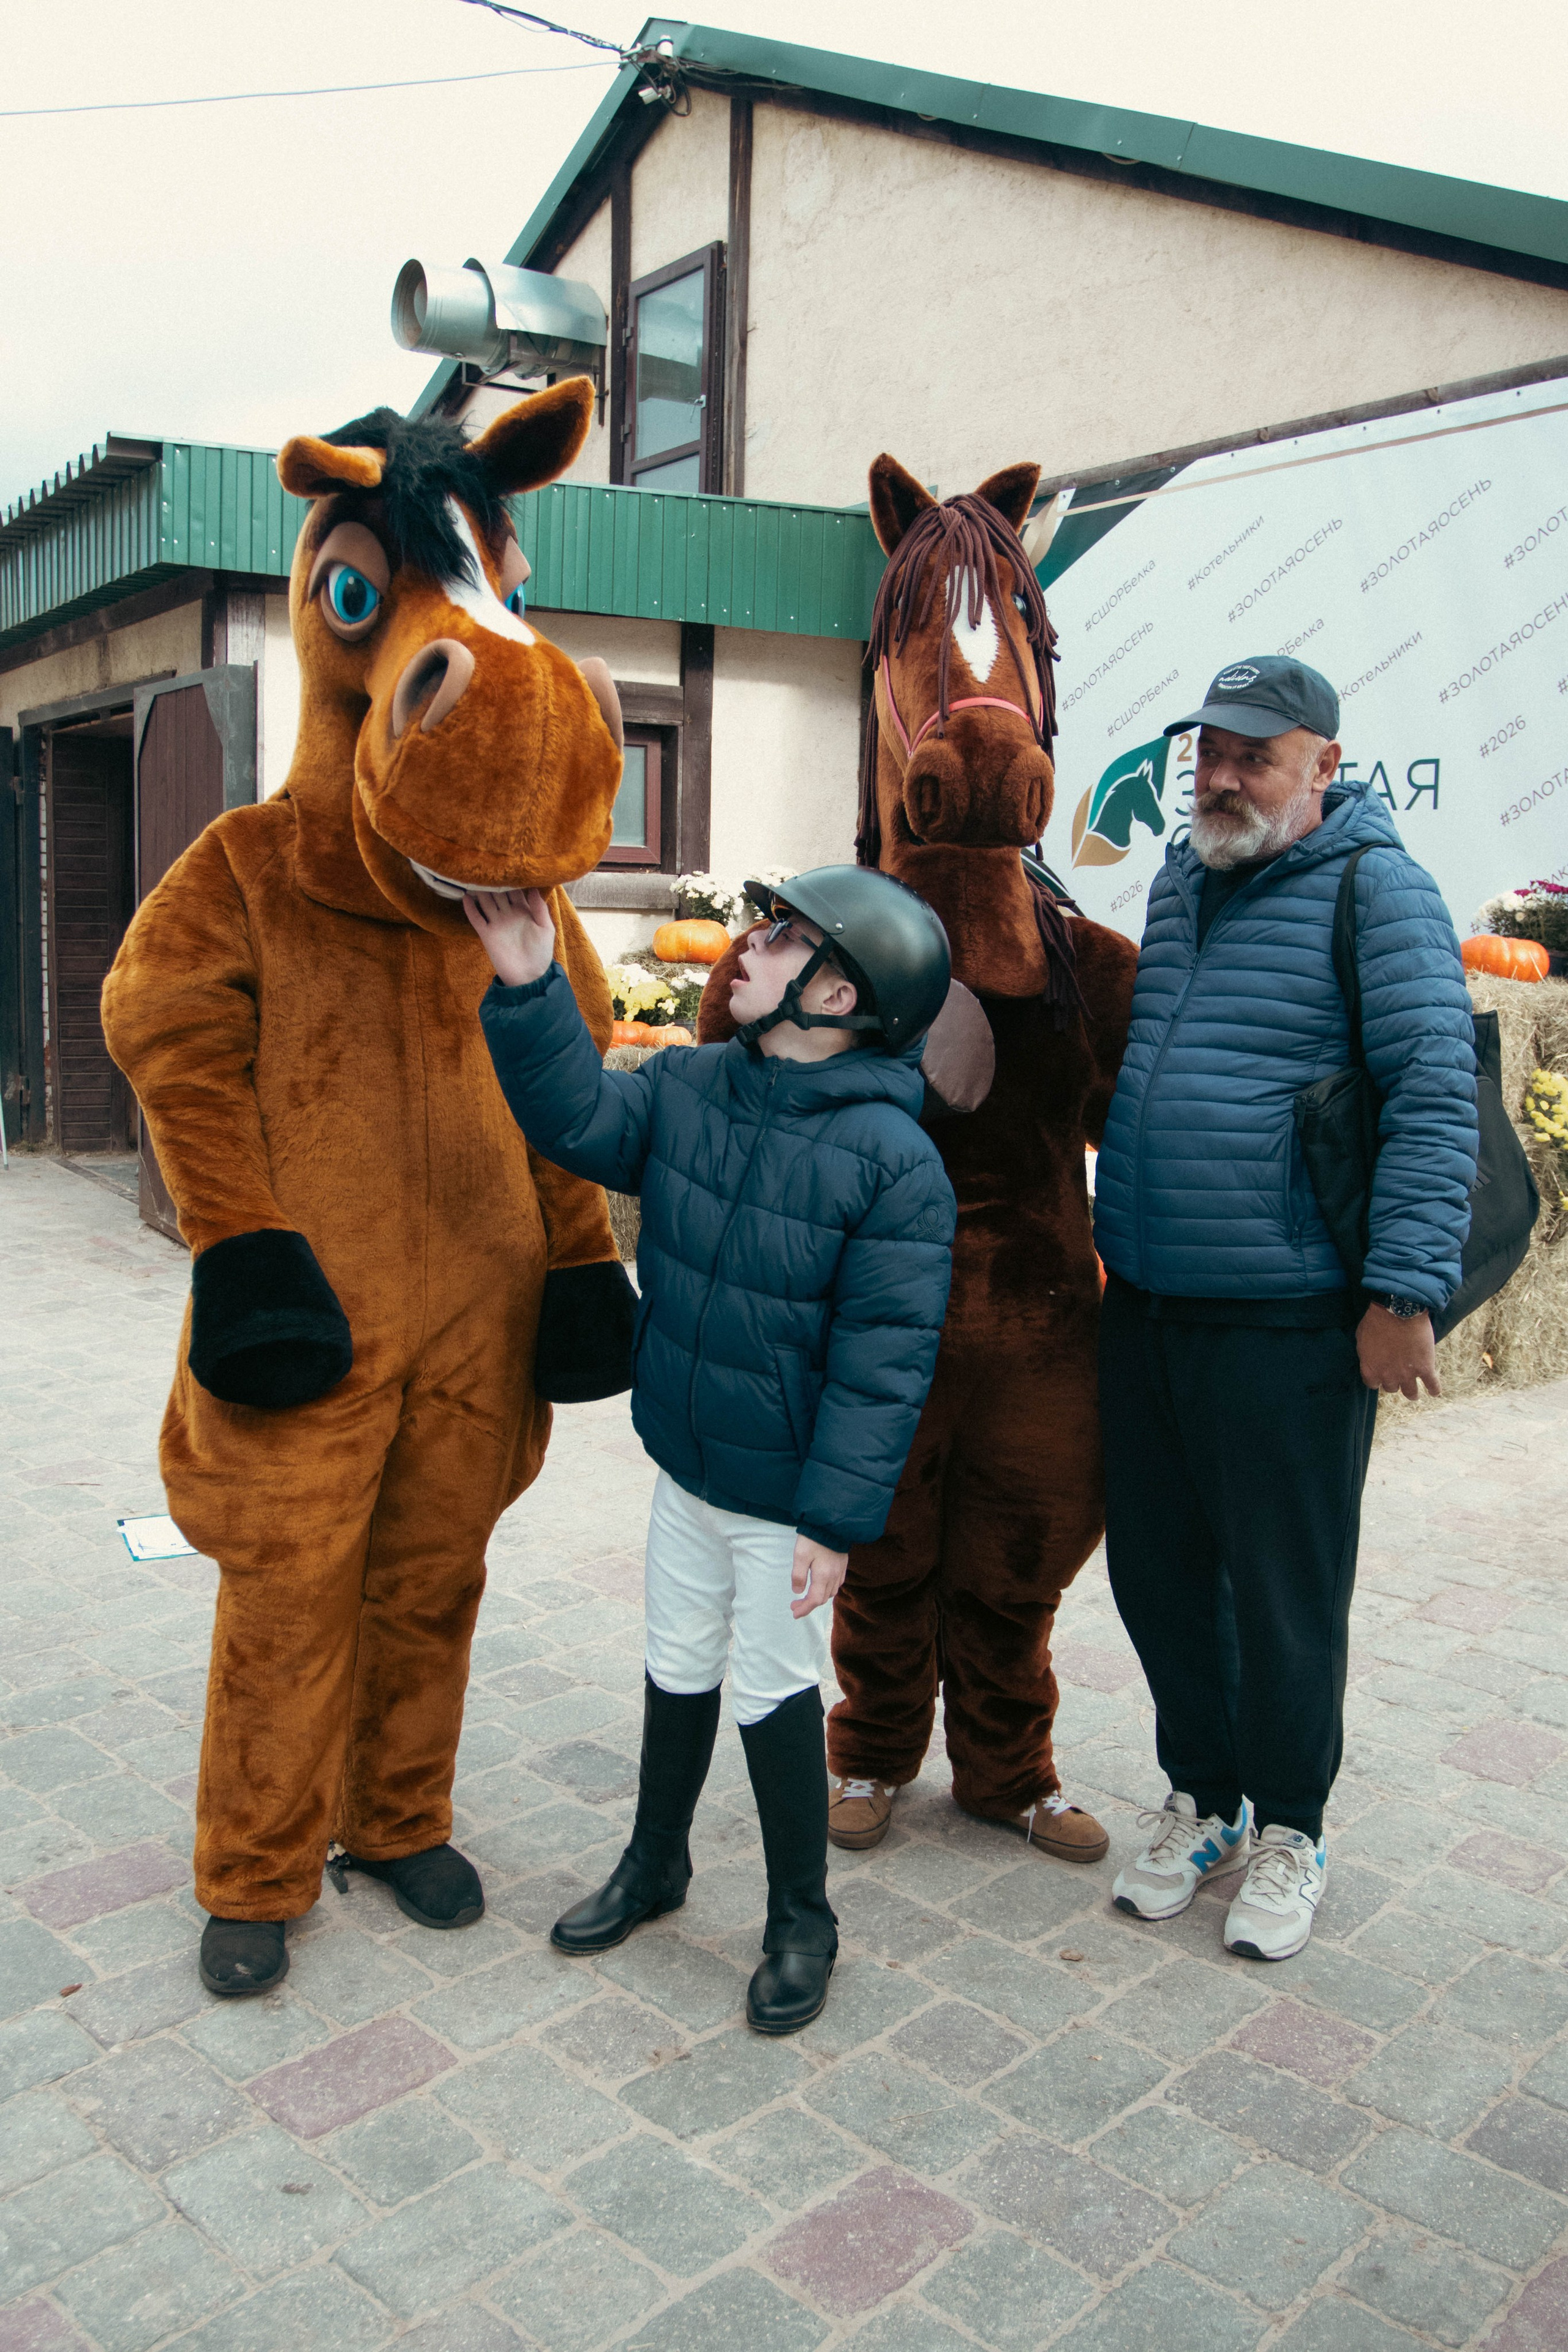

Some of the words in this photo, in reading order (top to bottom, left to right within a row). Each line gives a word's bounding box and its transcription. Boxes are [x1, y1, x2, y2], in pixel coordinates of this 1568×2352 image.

[1188, 514, 1265, 591] #Котельники
[1227, 518, 1343, 624] #ЗОЛОТАЯОСЕНЬ
[1360, 479, 1491, 594] #ЗОЛОТАЯОСЕНЬ
[1504, 506, 1568, 570] #ЗОЛОТ
[1084, 559, 1156, 632] #СШОРБелка
[1061, 622, 1154, 712] #ЗОЛОТАЯОСЕНЬ
[1276, 617, 1325, 657] РБелка
[1439, 592, 1568, 704] #ЗОЛОТАЯОСЕН
[1106, 668, 1180, 738] #СШОРБелка
[1479, 714, 1526, 759] #2026
[1110, 880, 1144, 913] #2026
